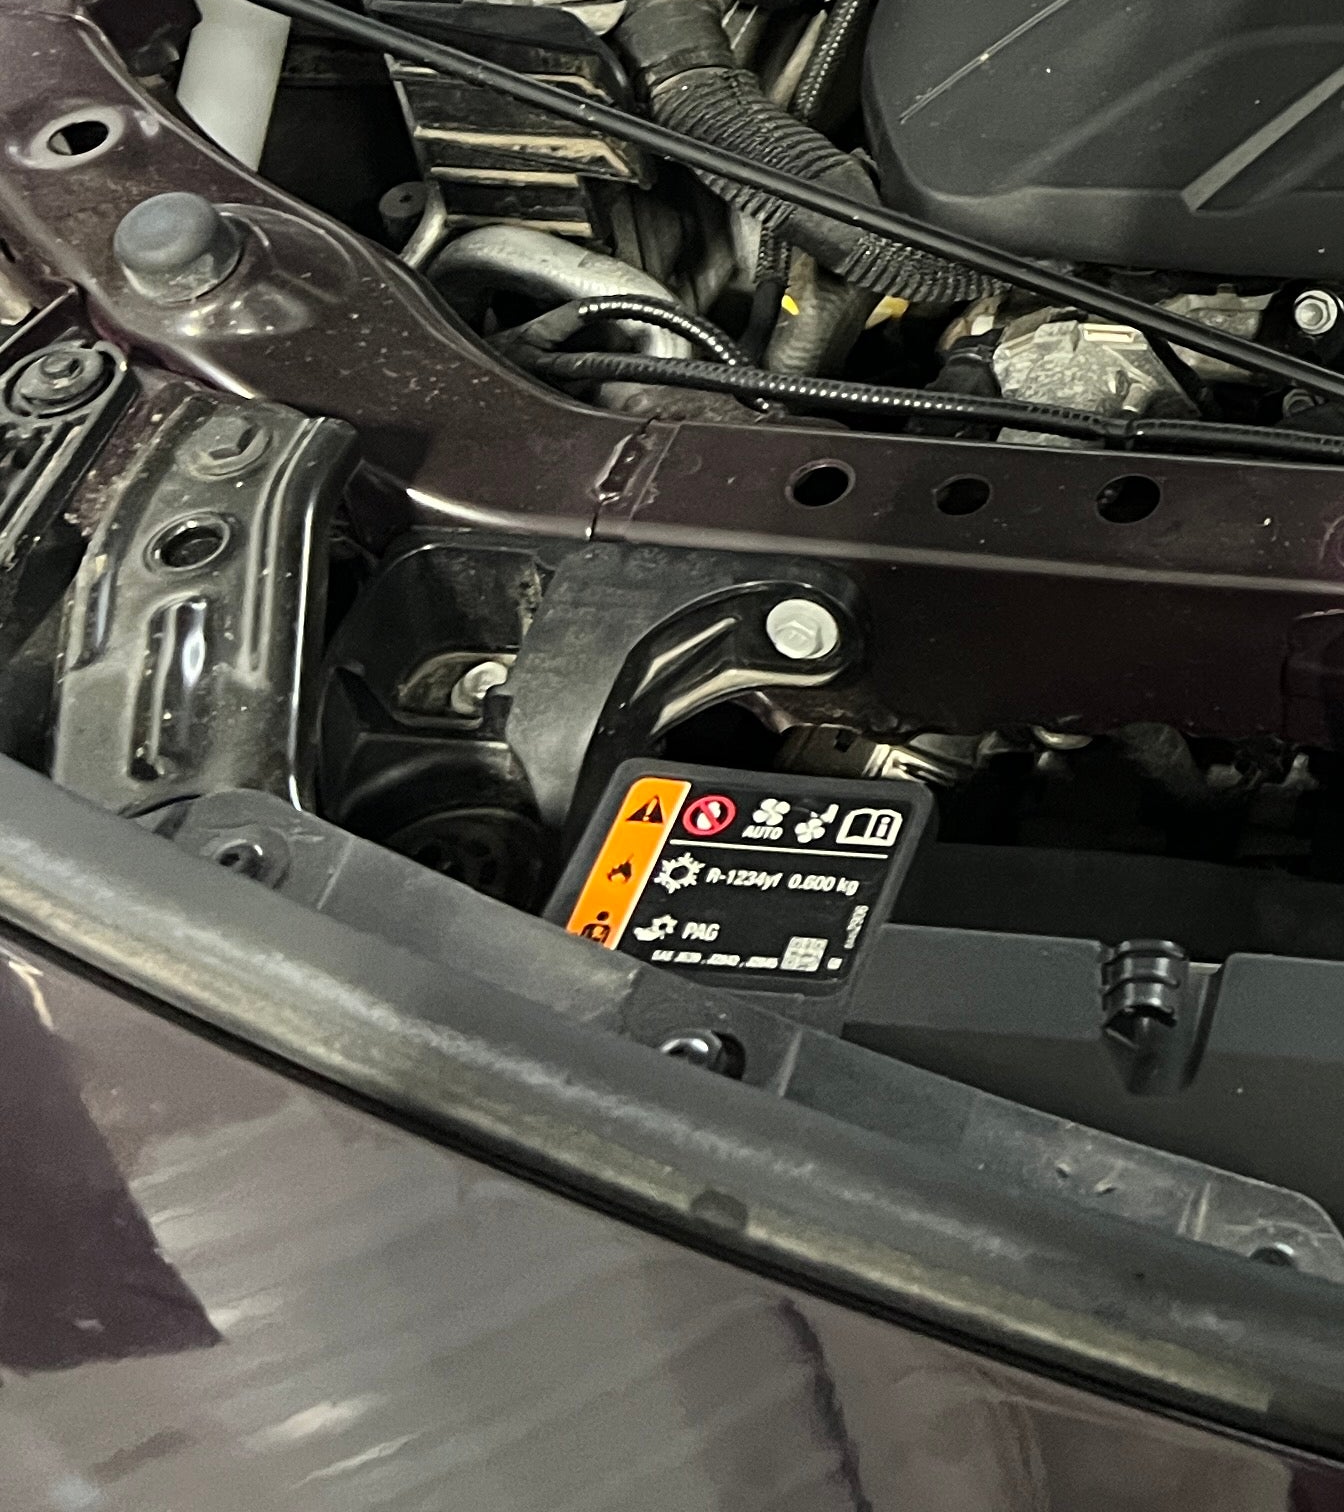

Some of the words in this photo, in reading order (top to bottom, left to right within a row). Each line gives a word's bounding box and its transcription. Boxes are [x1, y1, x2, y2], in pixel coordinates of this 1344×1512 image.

[741, 824, 784, 840] AUTO
[836, 877, 860, 896] kg
[681, 922, 721, 942] PAG
